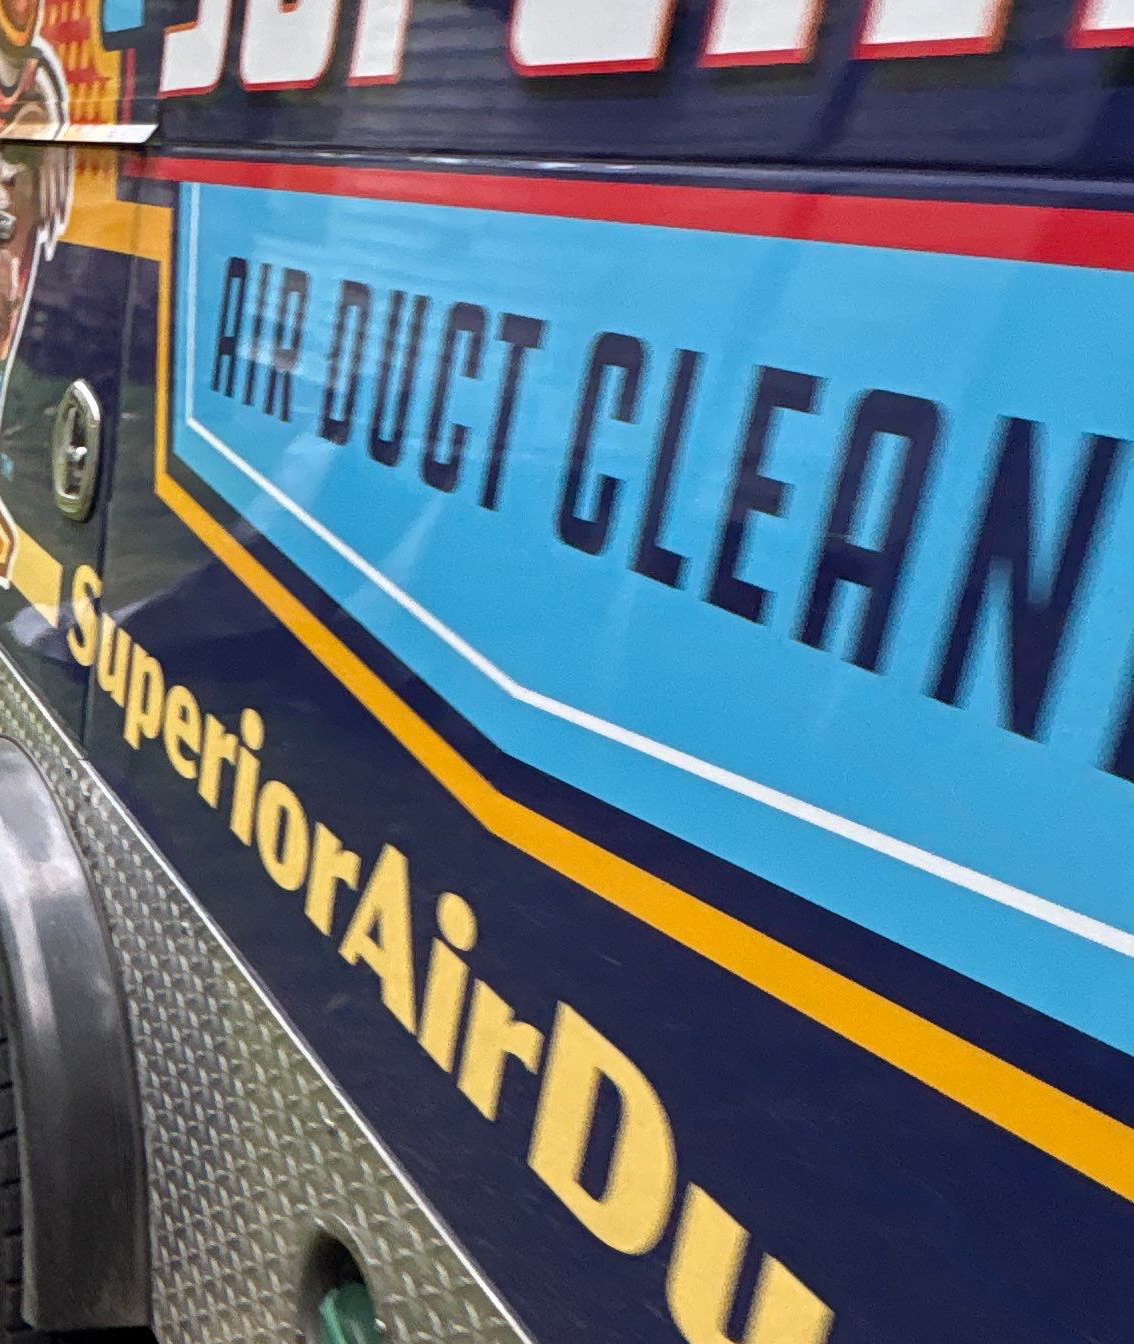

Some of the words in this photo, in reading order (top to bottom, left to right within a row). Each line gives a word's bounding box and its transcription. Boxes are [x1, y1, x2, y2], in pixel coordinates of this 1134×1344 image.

[211, 256, 313, 424] AIR
[319, 279, 550, 511] DUCT
[554, 331, 1134, 786] CLEAN
